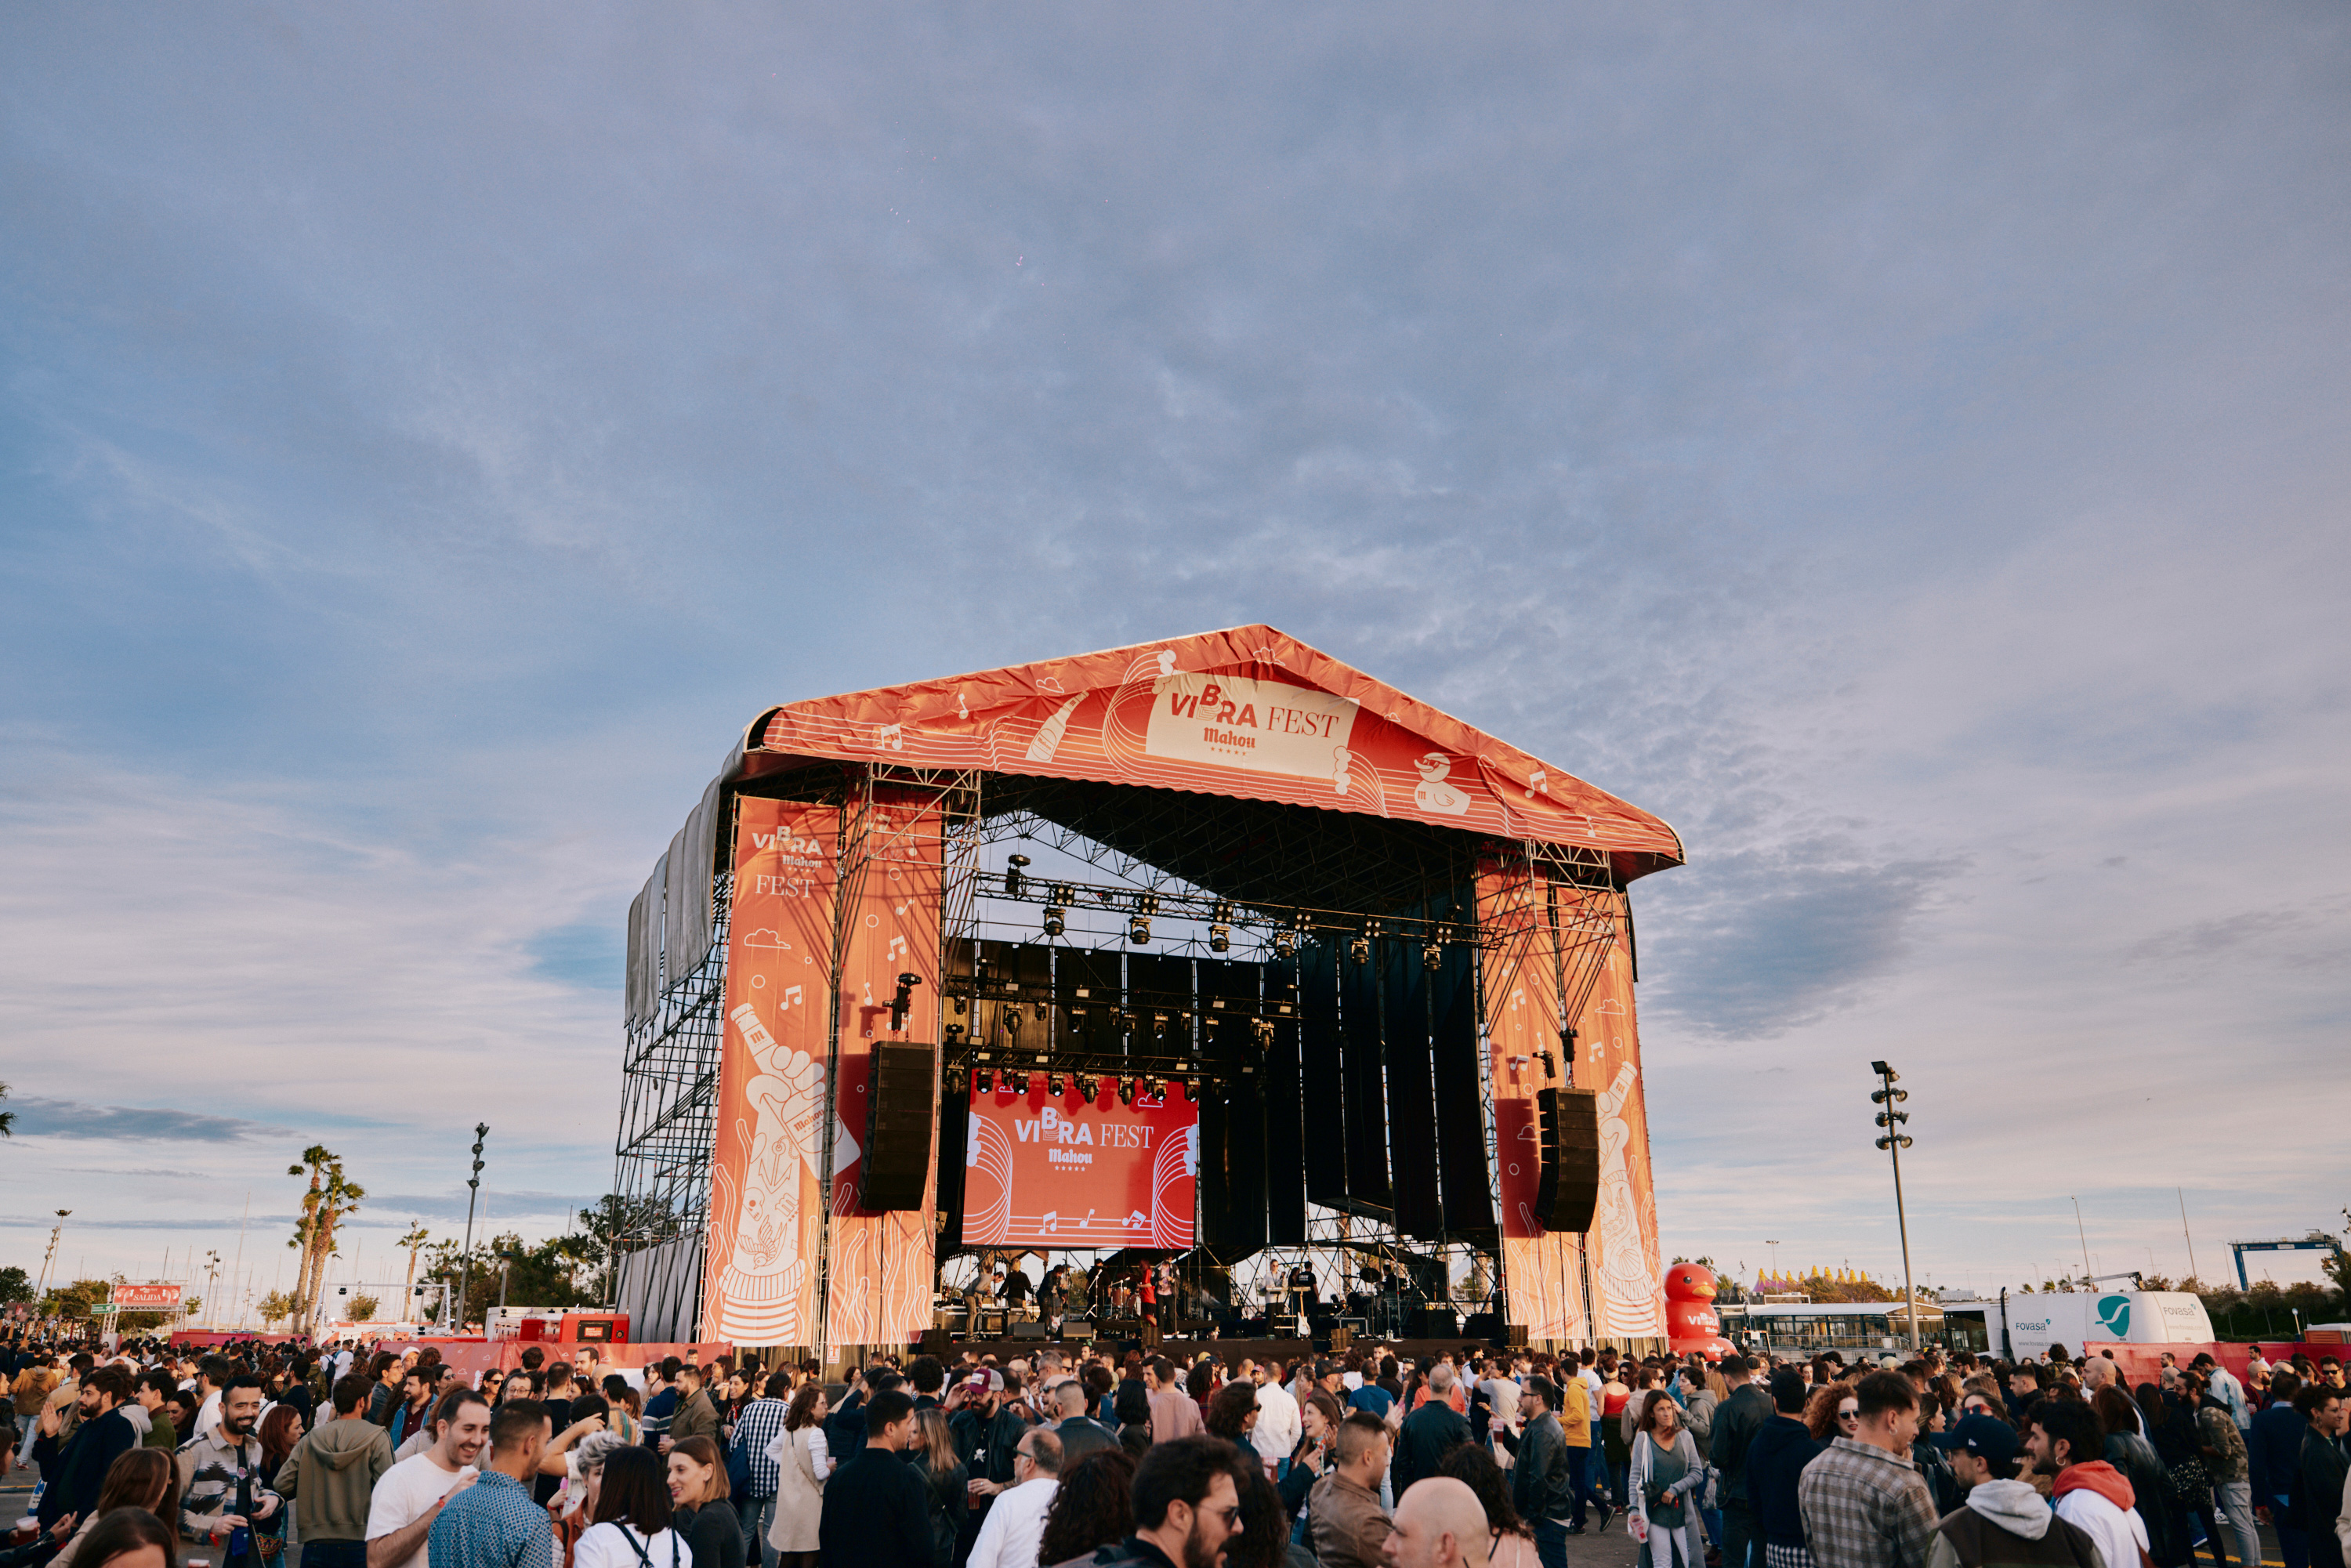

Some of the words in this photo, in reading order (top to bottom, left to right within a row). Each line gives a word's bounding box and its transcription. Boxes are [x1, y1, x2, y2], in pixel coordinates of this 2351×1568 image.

[1172, 683, 1258, 728] VIBRA
[1266, 706, 1339, 738] FEST
[1204, 727, 1255, 748] Mahou
[752, 825, 823, 855] VIBRA
[782, 854, 822, 868] Mahou
[755, 875, 814, 898] FEST
[1015, 1106, 1093, 1146] VIBRA
[1099, 1124, 1154, 1149] FEST
[1049, 1148, 1092, 1164] Mahou
[1687, 1313, 1719, 1327] VIBRA
